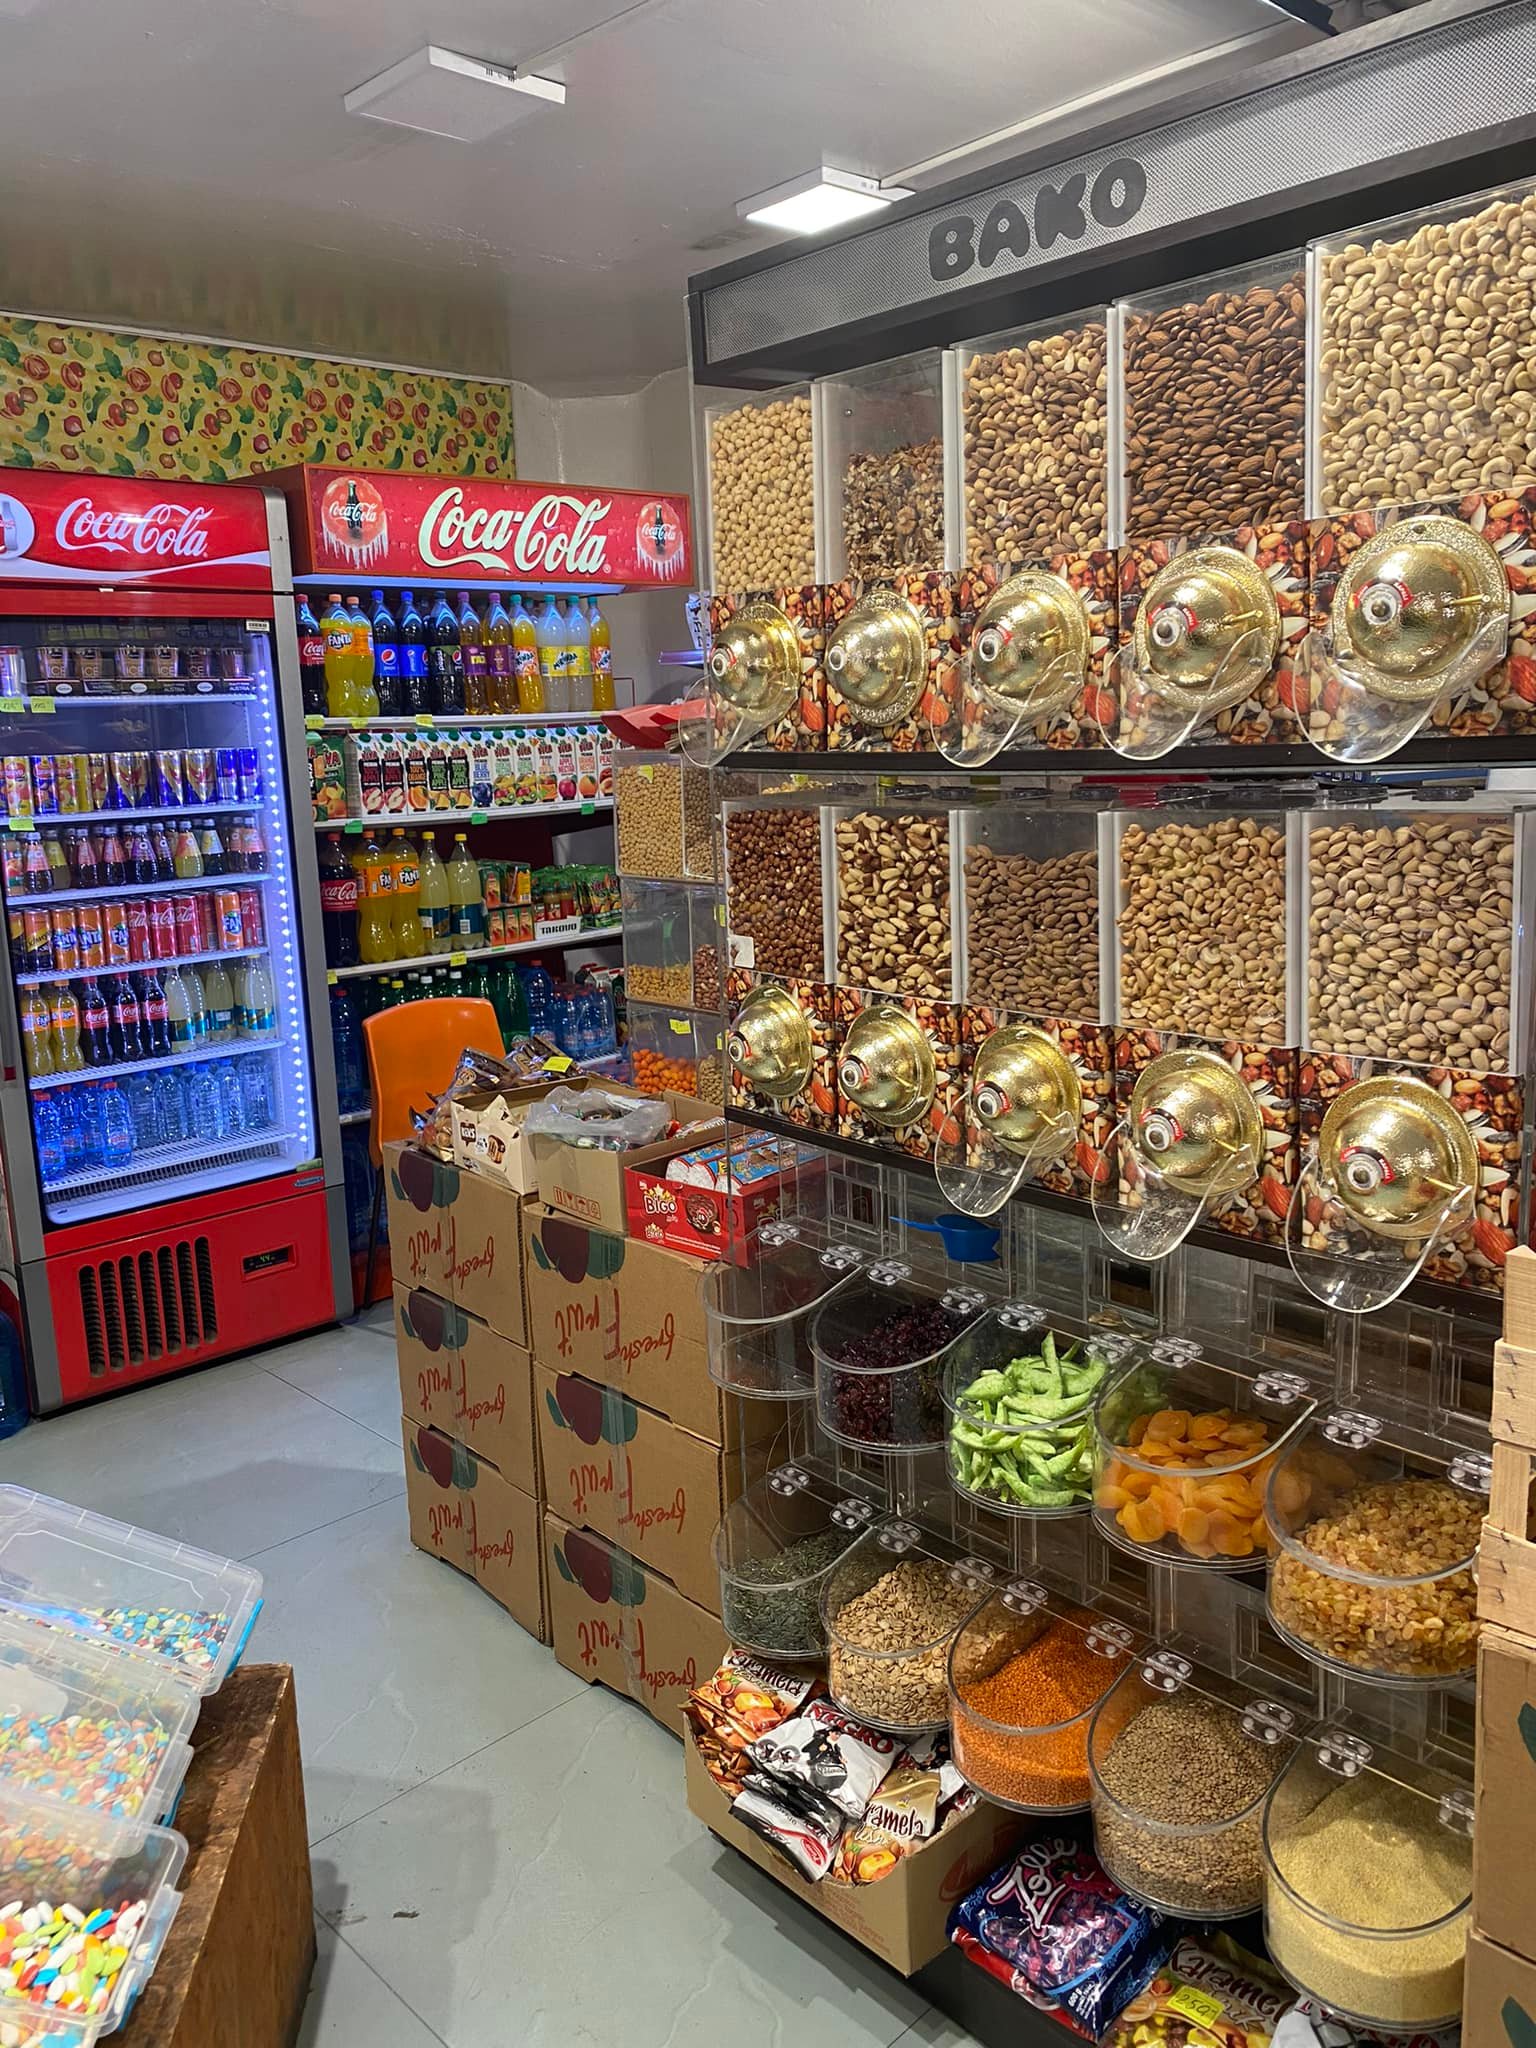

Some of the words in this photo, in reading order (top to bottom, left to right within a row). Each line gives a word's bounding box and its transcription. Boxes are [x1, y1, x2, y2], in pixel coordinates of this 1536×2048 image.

[929, 157, 1147, 281] BAKO
[55, 497, 214, 557] Coca-Cola
[330, 500, 377, 523] Coca-Cola
[418, 487, 612, 574] Coca-Cola
[640, 522, 676, 541] Coca-Cola
[540, 922, 578, 935] TAKOVO
